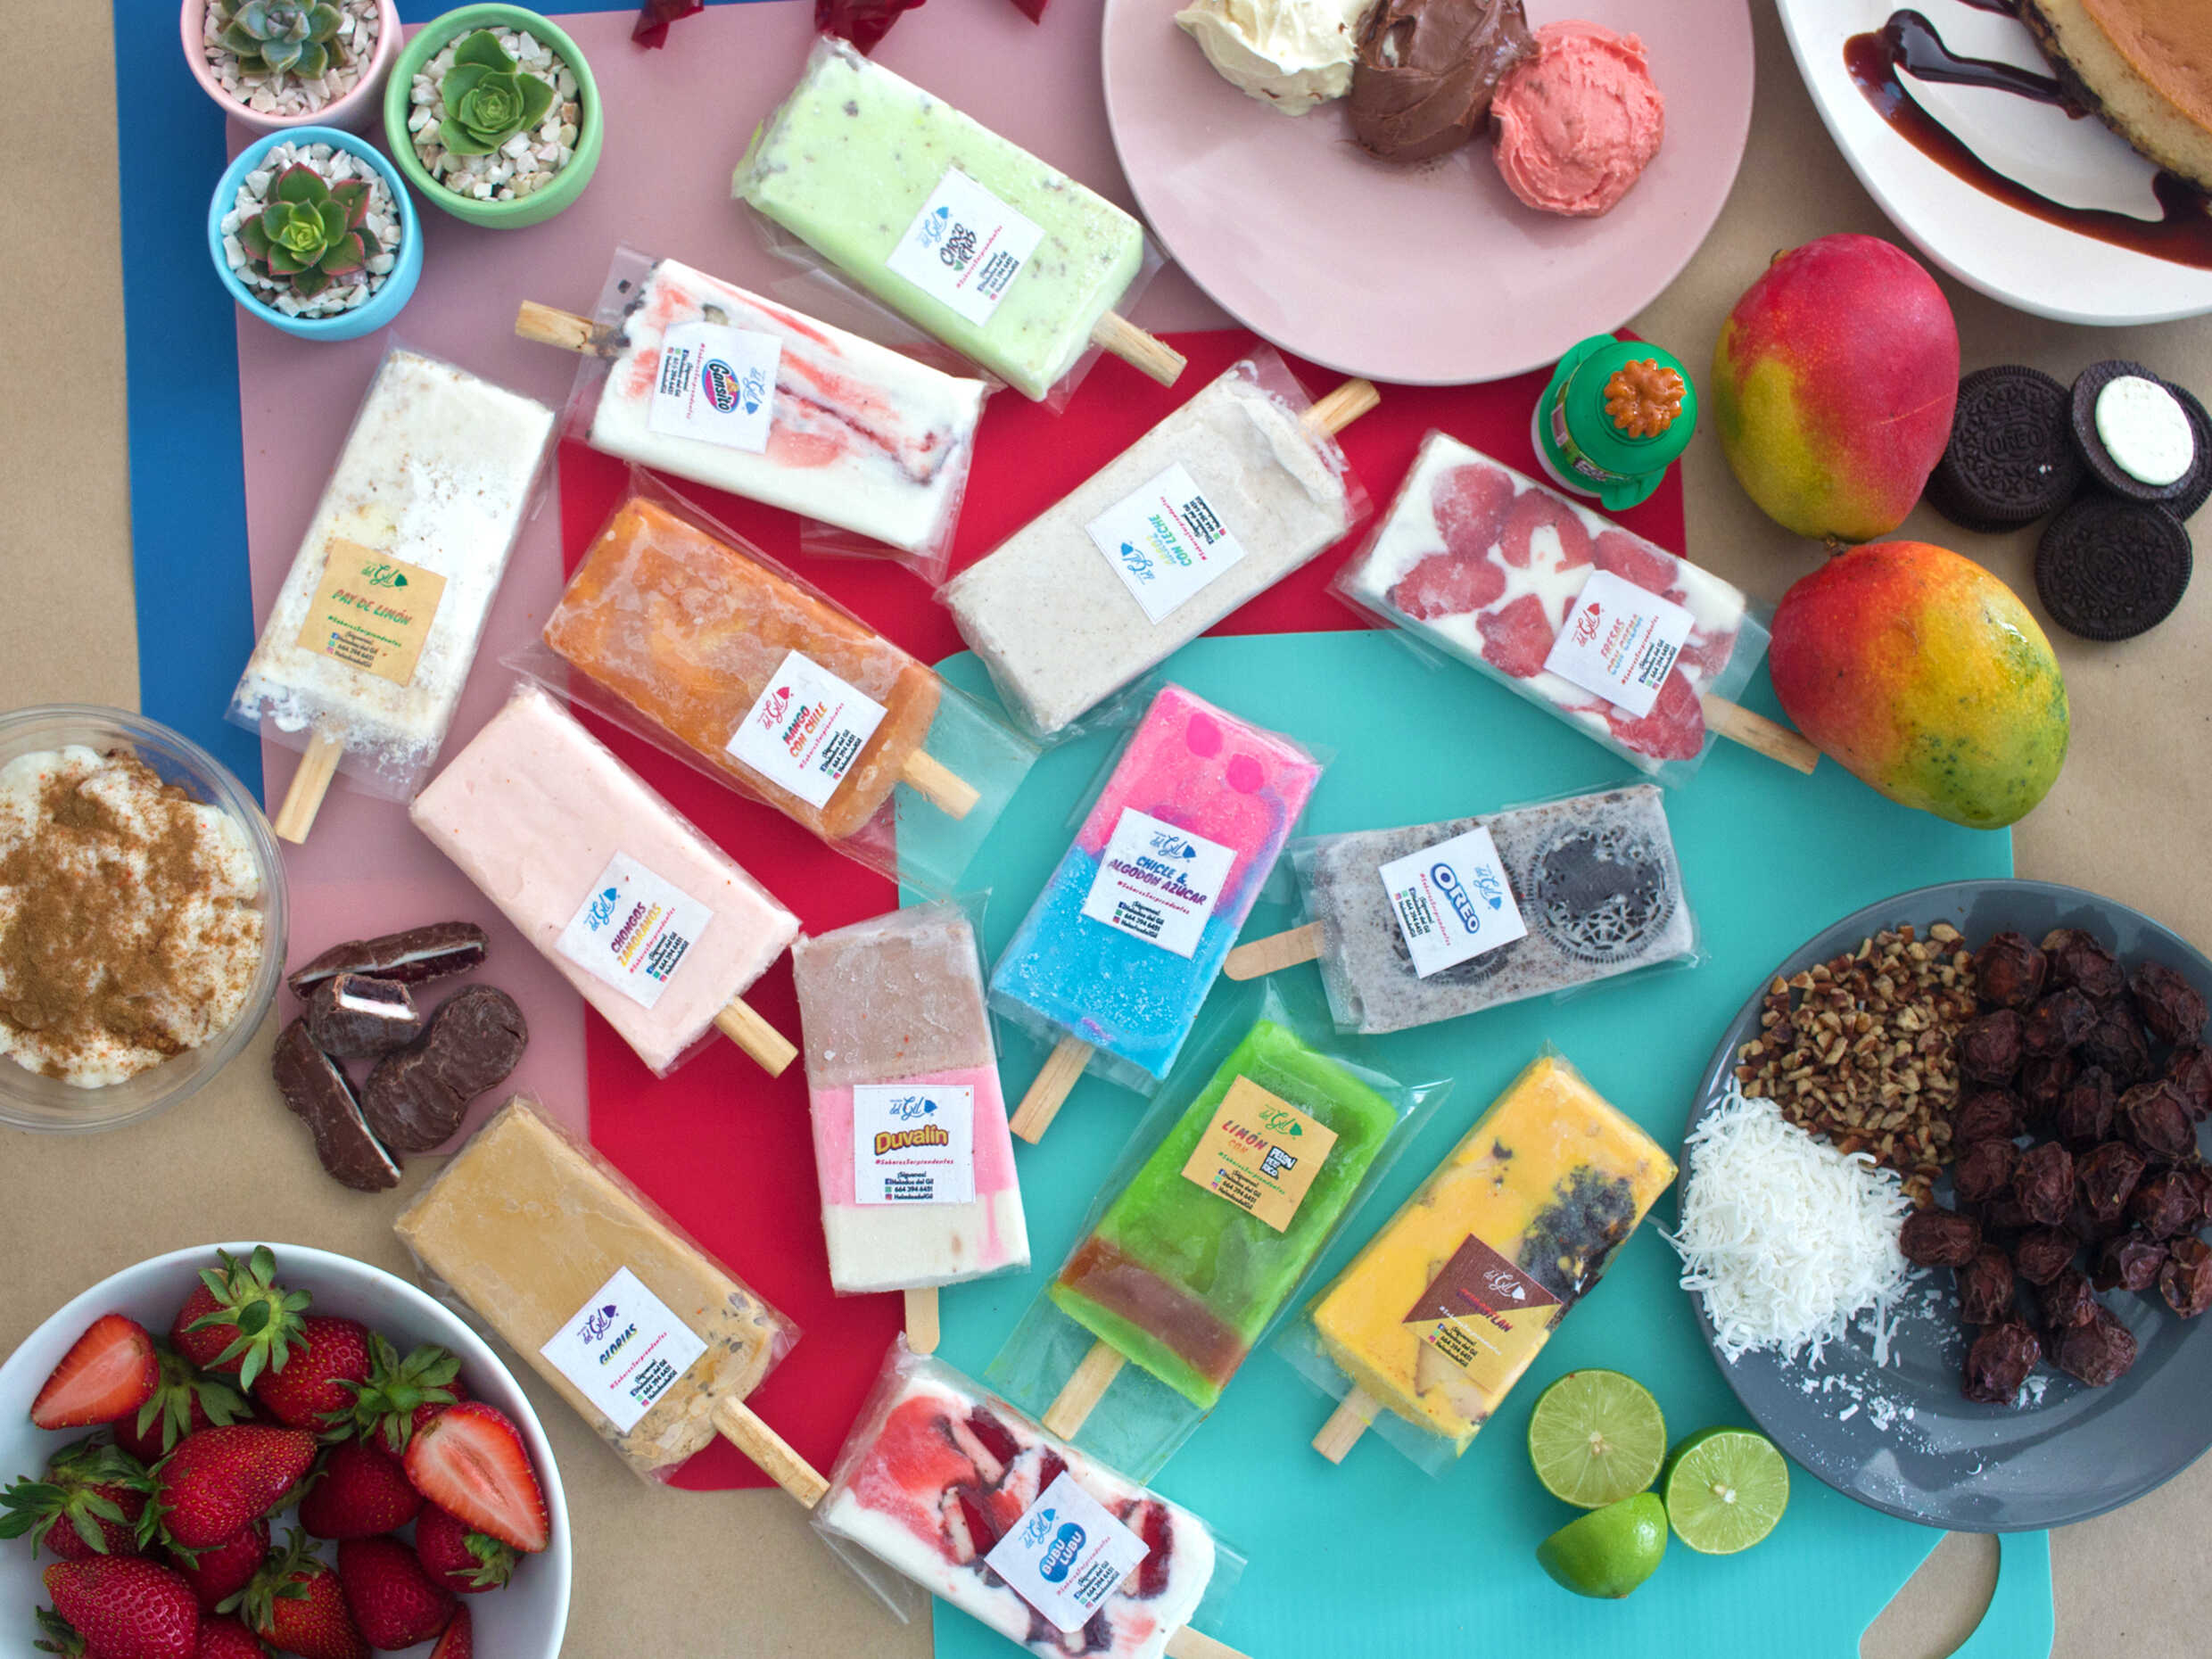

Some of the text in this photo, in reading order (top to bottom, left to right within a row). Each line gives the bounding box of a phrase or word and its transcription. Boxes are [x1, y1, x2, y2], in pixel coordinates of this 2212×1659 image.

[708, 363, 731, 411] Gansito
[1988, 428, 2043, 455] OREO
[1148, 514, 1193, 566] CON LECHE
[331, 589, 412, 625] PAY DE LIMÓN
[1600, 617, 1624, 659] FRESAS
[781, 705, 810, 745] MANGO
[788, 701, 828, 757] CON CHILE
[1108, 859, 1161, 886] ALGODON
[1135, 855, 1176, 879] CHICLE
[1432, 864, 1479, 933] OREO
[610, 901, 646, 953] CHONGOS
[616, 902, 662, 967] ZAMORANOS
[1221, 1119, 1268, 1151] LIMÓN
[1227, 1139, 1249, 1153] CON
[598, 1323, 638, 1366] GLORIAS
[1041, 1538, 1067, 1574] BUBU
[1059, 1530, 1083, 1564] LUBU
